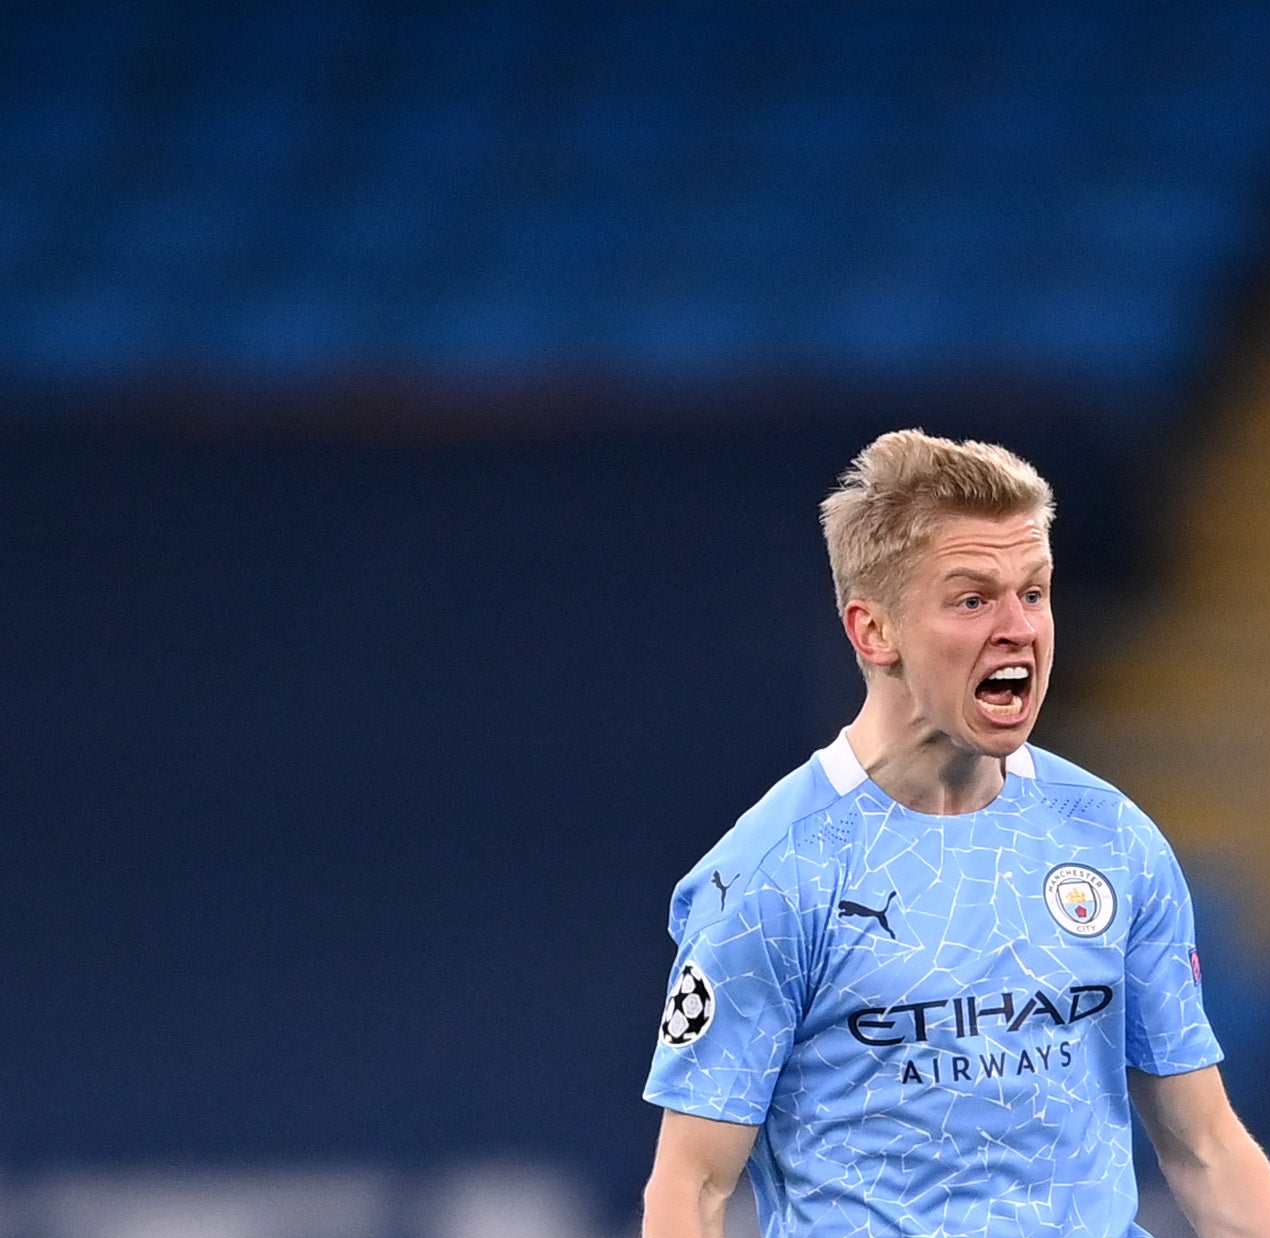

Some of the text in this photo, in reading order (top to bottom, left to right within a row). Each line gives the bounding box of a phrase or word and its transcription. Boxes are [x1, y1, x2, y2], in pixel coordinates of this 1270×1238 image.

[1048, 869, 1103, 893] MANCHESTER
[1076, 924, 1096, 933] CITY
[847, 984, 1113, 1047] ETIHAD
[902, 1041, 1072, 1084] AIRWAYS
